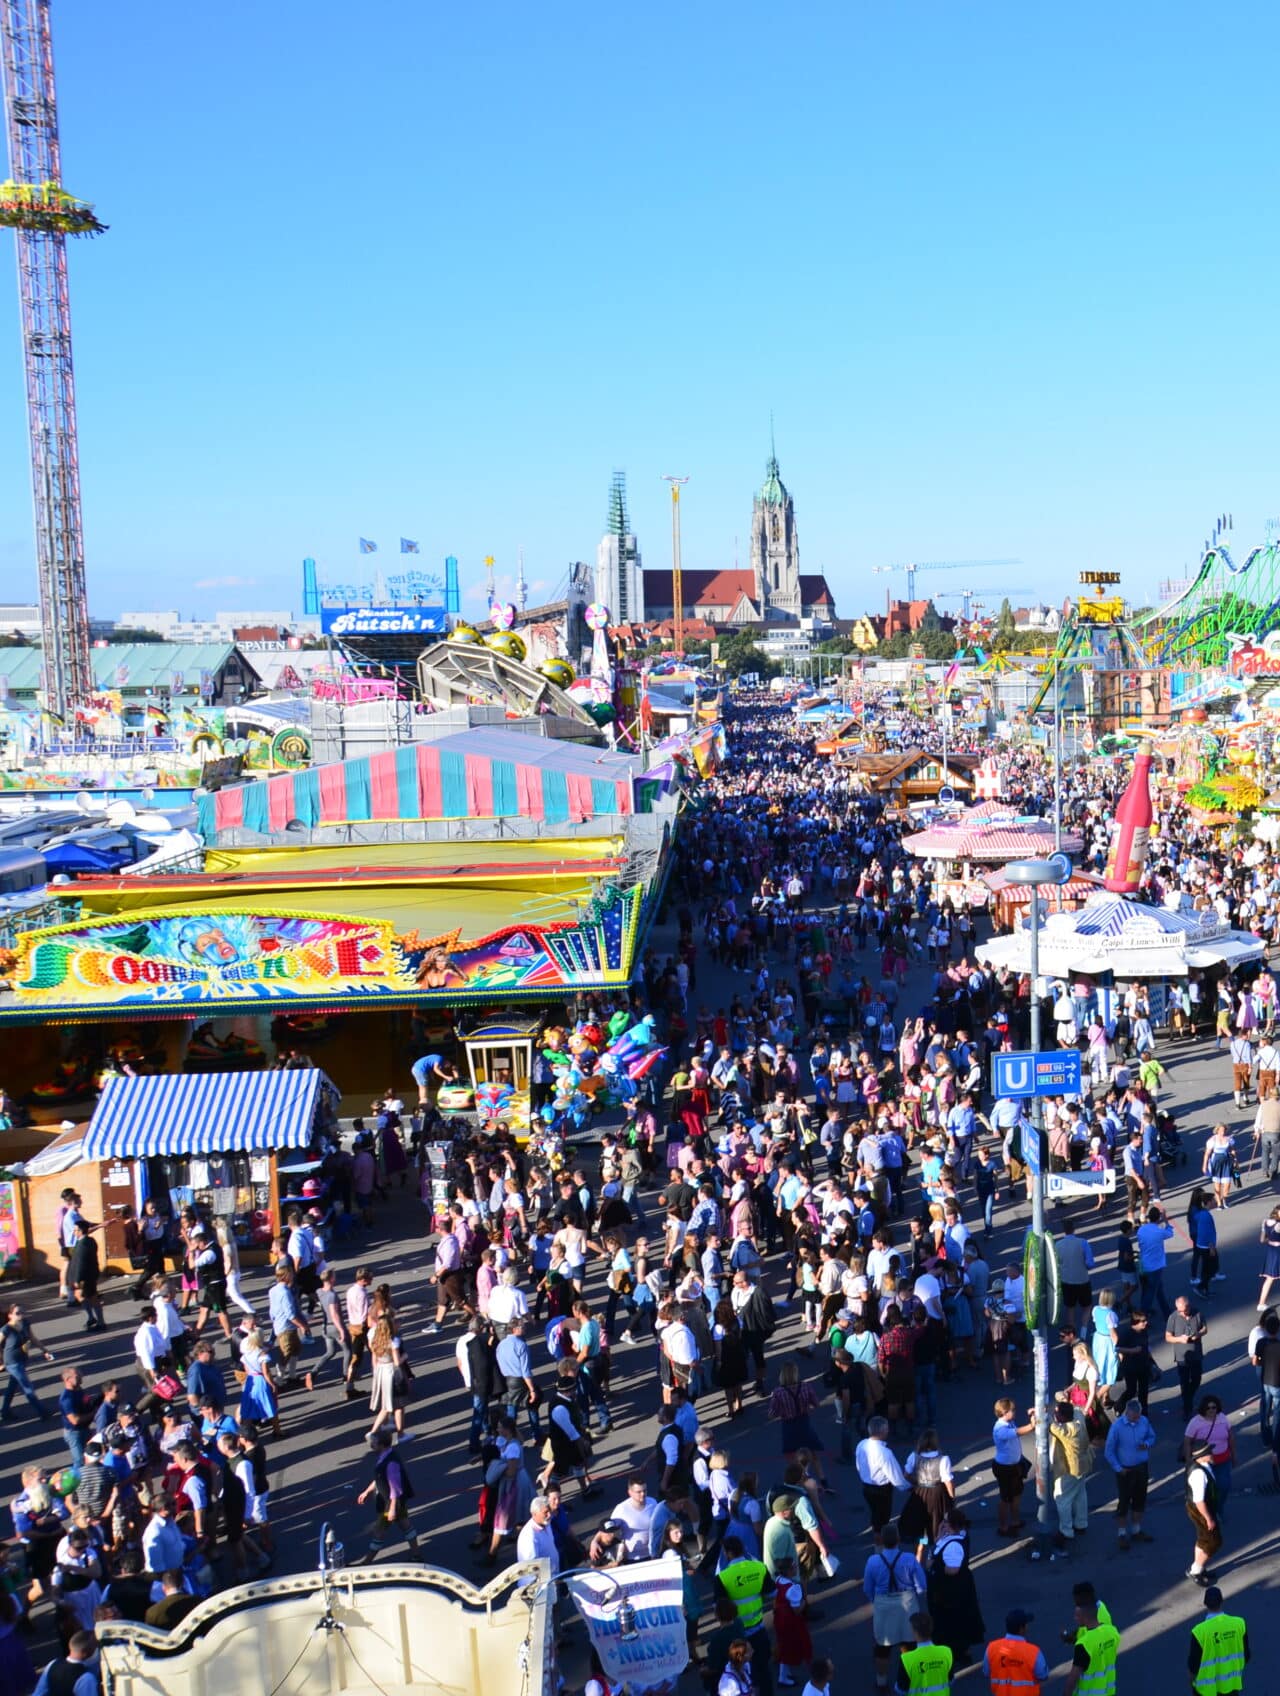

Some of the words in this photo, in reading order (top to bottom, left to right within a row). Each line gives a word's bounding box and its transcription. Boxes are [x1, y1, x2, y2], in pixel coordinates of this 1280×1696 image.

[236, 641, 286, 651] SPATEN
[1101, 936, 1124, 947] Caipi
[1130, 935, 1154, 946] Limes
[1161, 933, 1181, 945] Willi
[263, 931, 386, 979] ZONE
[1005, 1061, 1027, 1089] U
[1051, 1180, 1061, 1190] U
